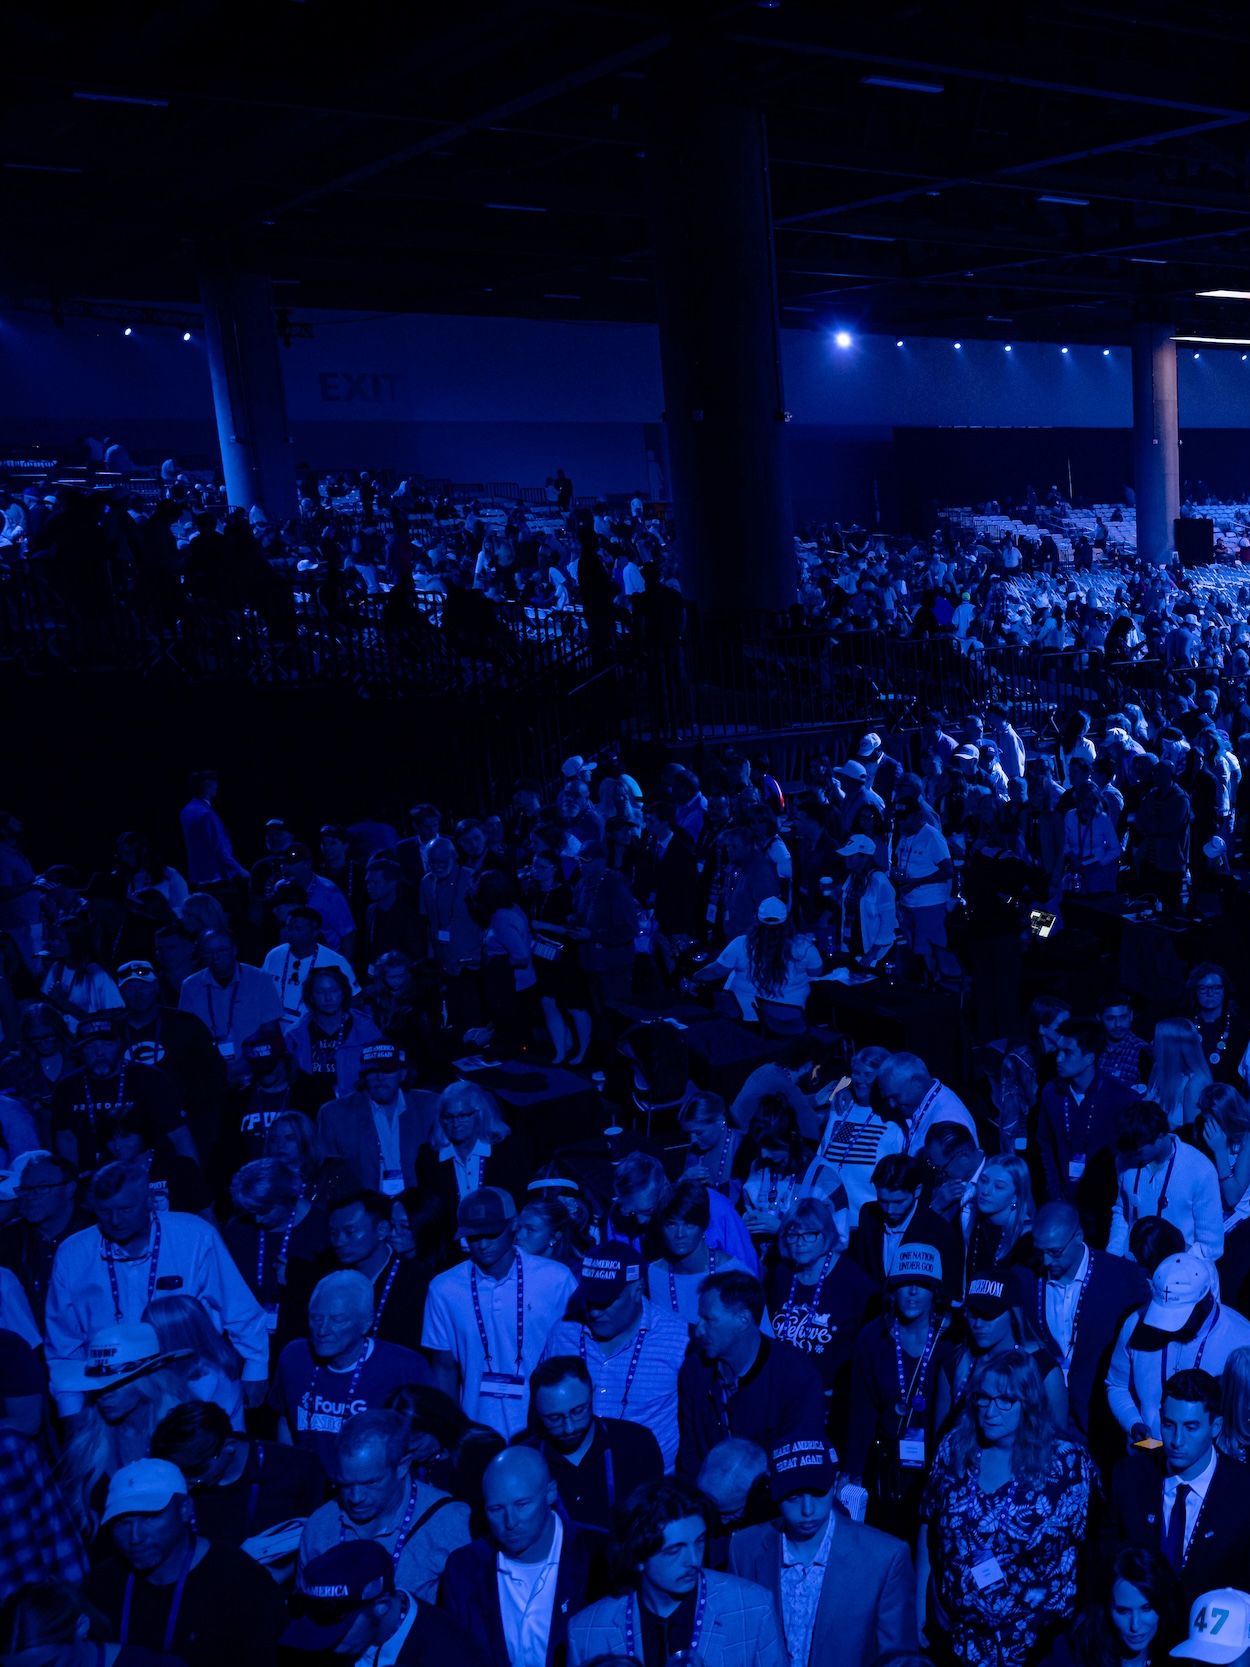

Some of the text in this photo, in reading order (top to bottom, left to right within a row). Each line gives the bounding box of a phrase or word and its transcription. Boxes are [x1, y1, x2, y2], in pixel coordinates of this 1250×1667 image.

[319, 371, 395, 402] EXIT
[792, 1440, 825, 1453] AMERICA
[800, 1454, 823, 1467] AGAIN
[1193, 1607, 1230, 1636] 47
